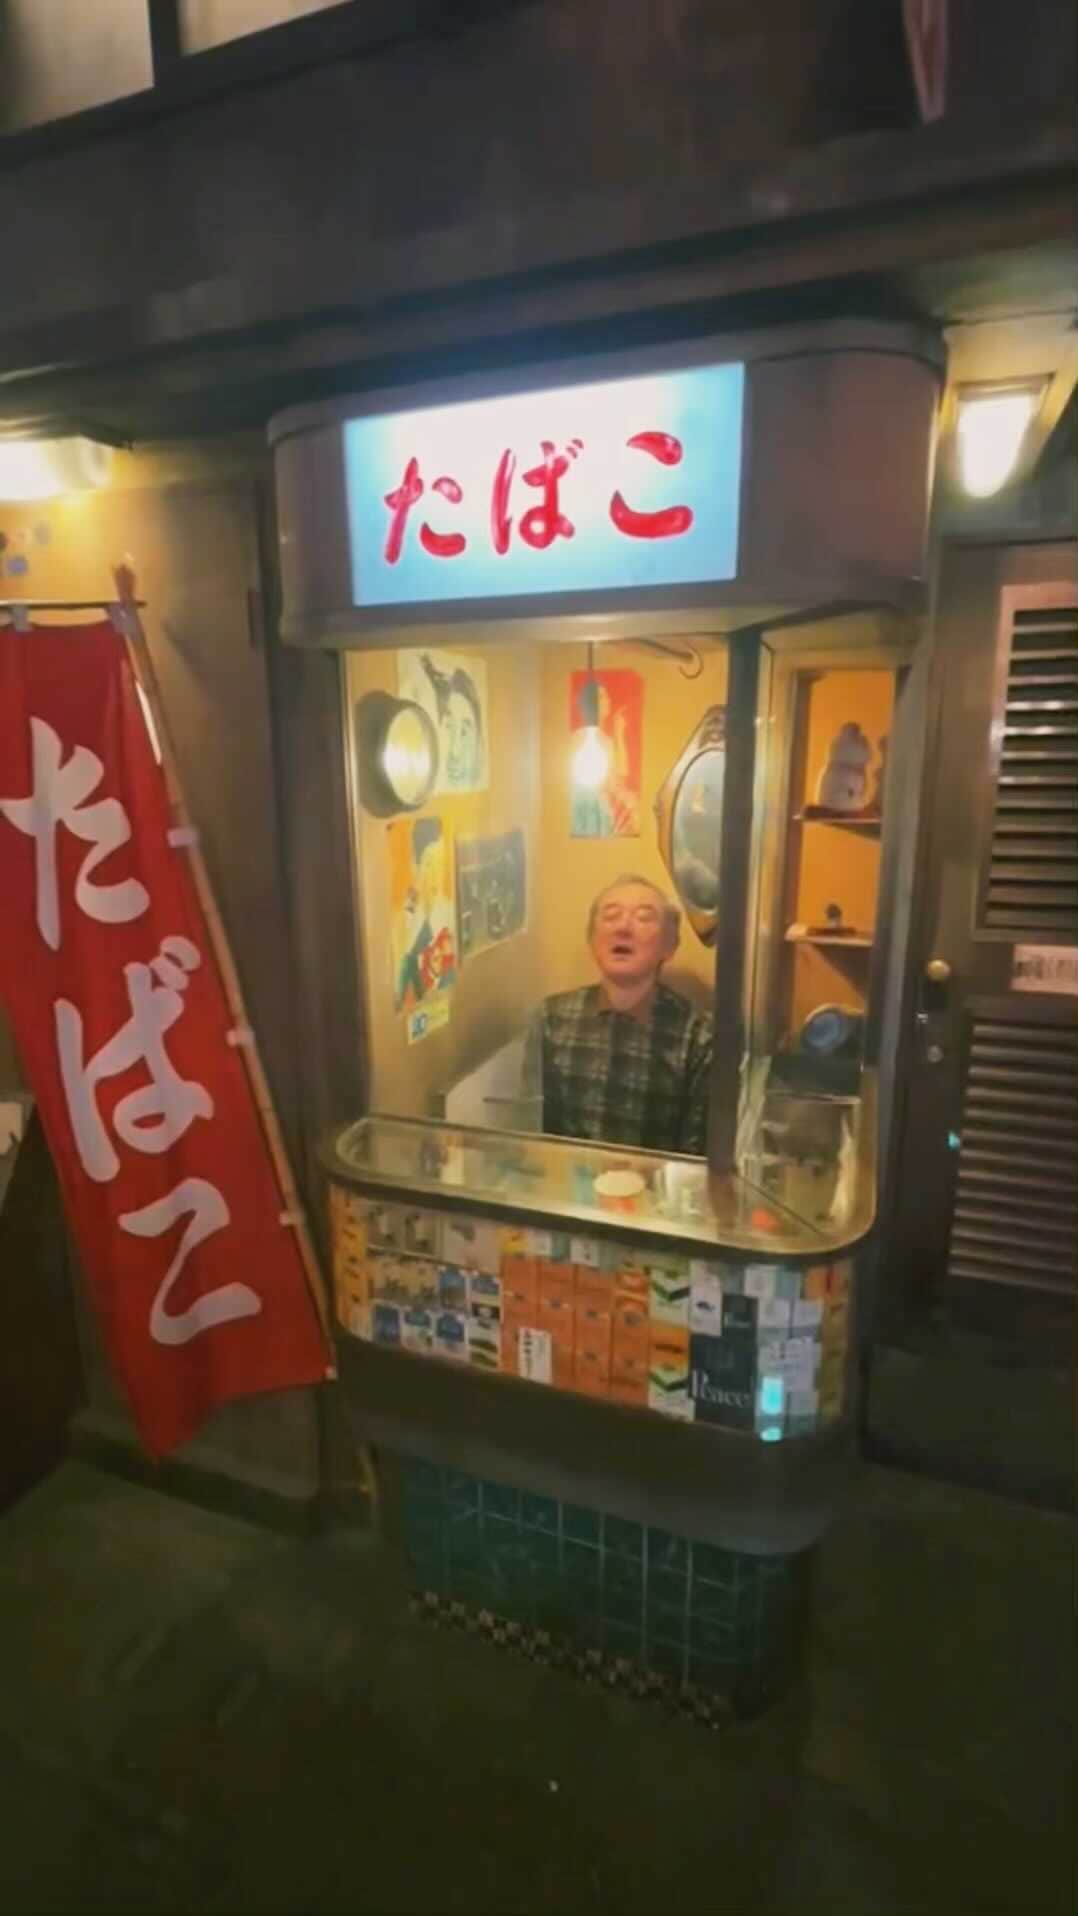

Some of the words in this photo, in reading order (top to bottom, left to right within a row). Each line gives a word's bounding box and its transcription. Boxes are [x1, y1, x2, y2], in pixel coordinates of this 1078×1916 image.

[383, 430, 694, 565] たばこ
[2, 716, 262, 1347] たばこ
[691, 1369, 752, 1408] Peace
